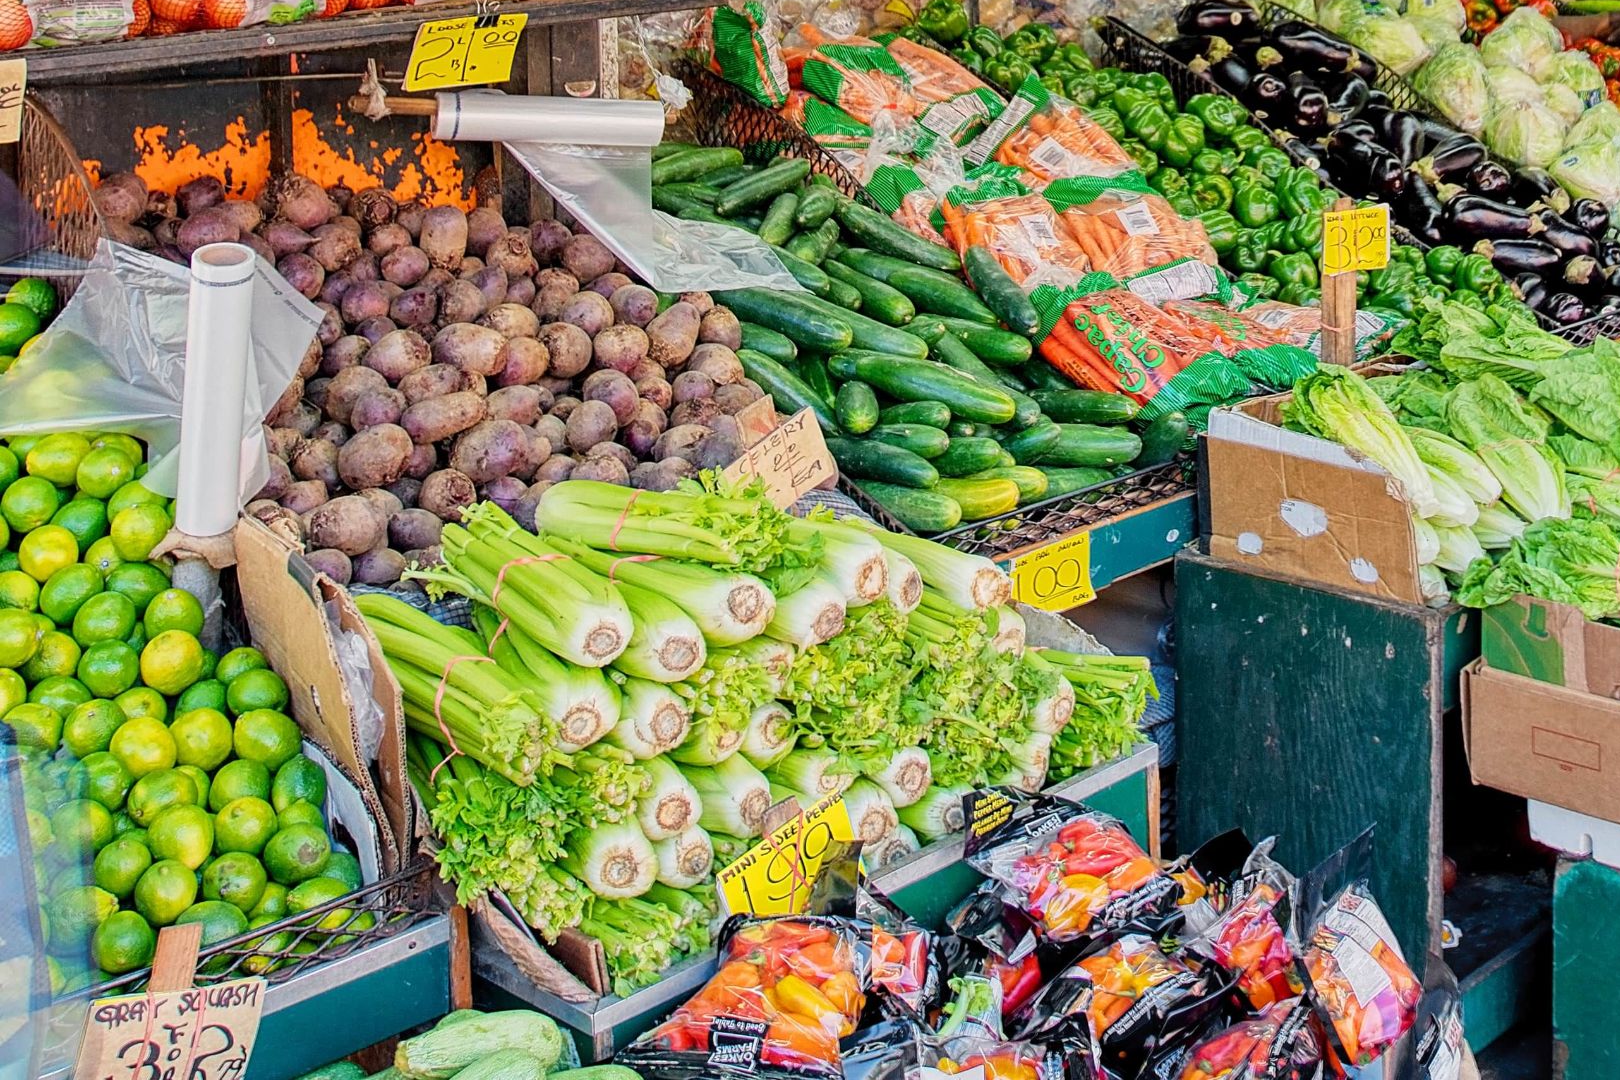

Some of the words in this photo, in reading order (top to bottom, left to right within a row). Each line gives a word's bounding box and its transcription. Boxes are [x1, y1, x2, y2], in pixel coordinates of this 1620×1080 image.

[428, 22, 467, 33] LOOSE
[415, 37, 455, 81] 2
[1089, 302, 1166, 368] Chief
[1074, 312, 1147, 393] Capac
[740, 413, 806, 474] CELERY
[791, 459, 822, 488] EA
[1031, 816, 1058, 837] OAKES
[722, 854, 757, 883] MINI
[95, 998, 168, 1030] GRAY
[713, 1051, 755, 1063] OAKES
[715, 1041, 756, 1055] FARMS
